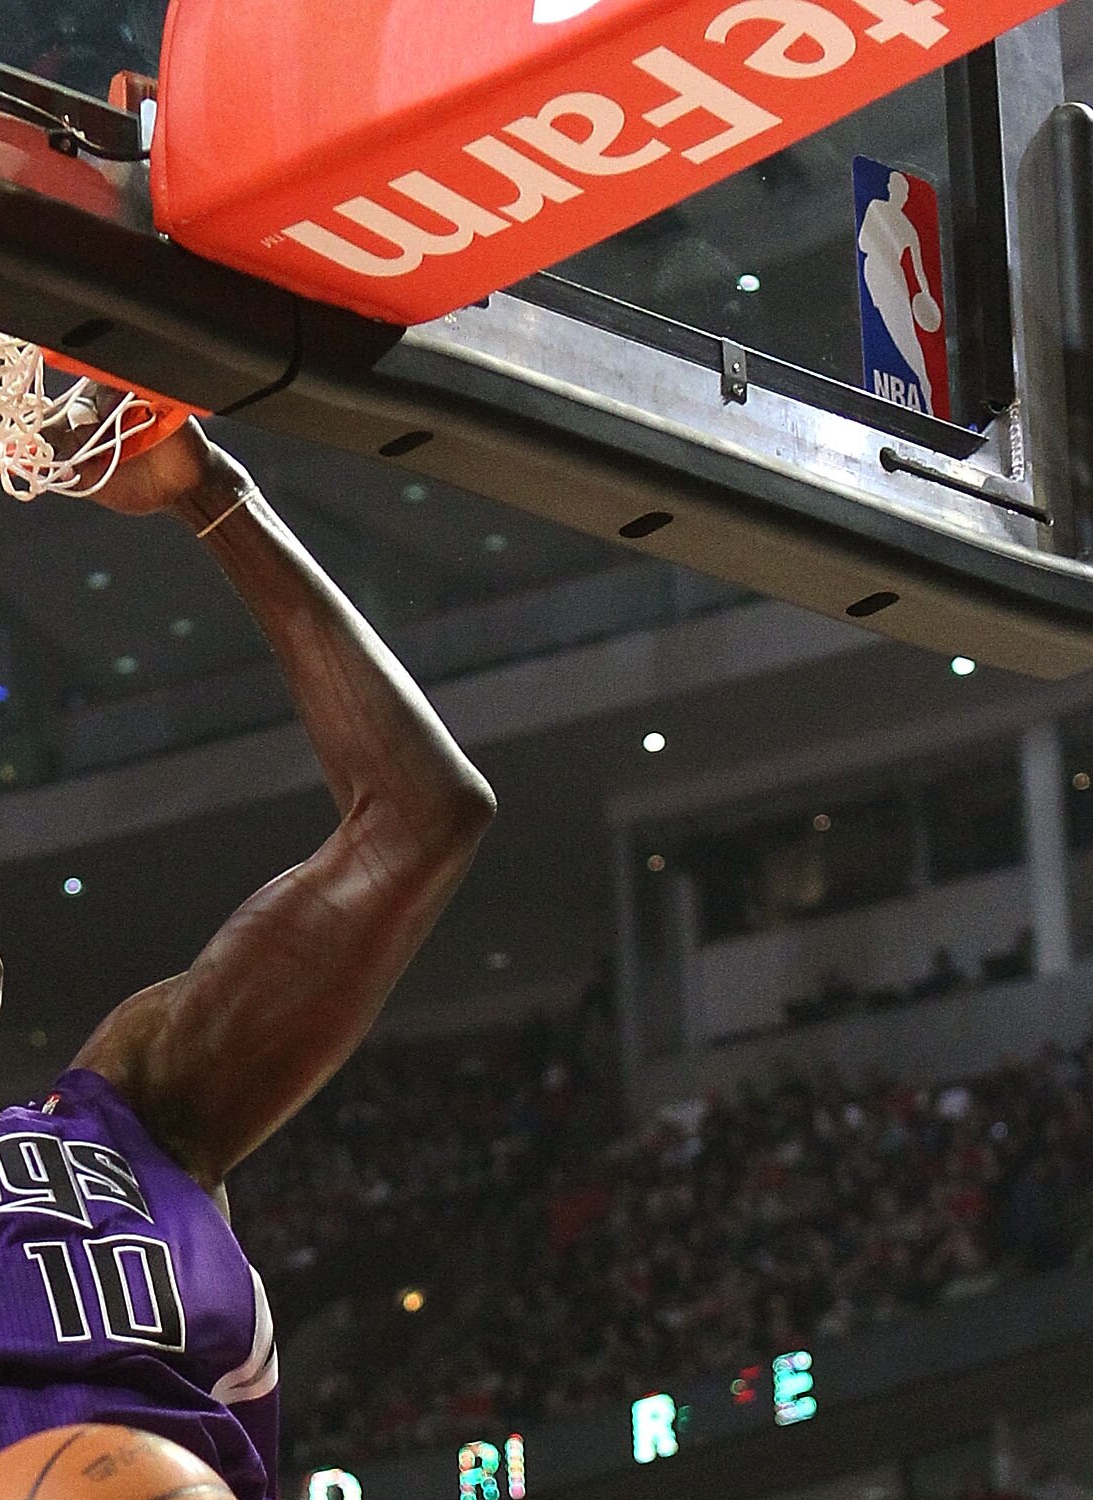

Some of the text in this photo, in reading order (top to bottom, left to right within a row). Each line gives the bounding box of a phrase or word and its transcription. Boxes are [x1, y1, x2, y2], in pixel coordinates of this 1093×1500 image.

[281, 45, 783, 277] Farm
[873, 369, 922, 412] NBA
[23, 1234, 185, 1353] 10
